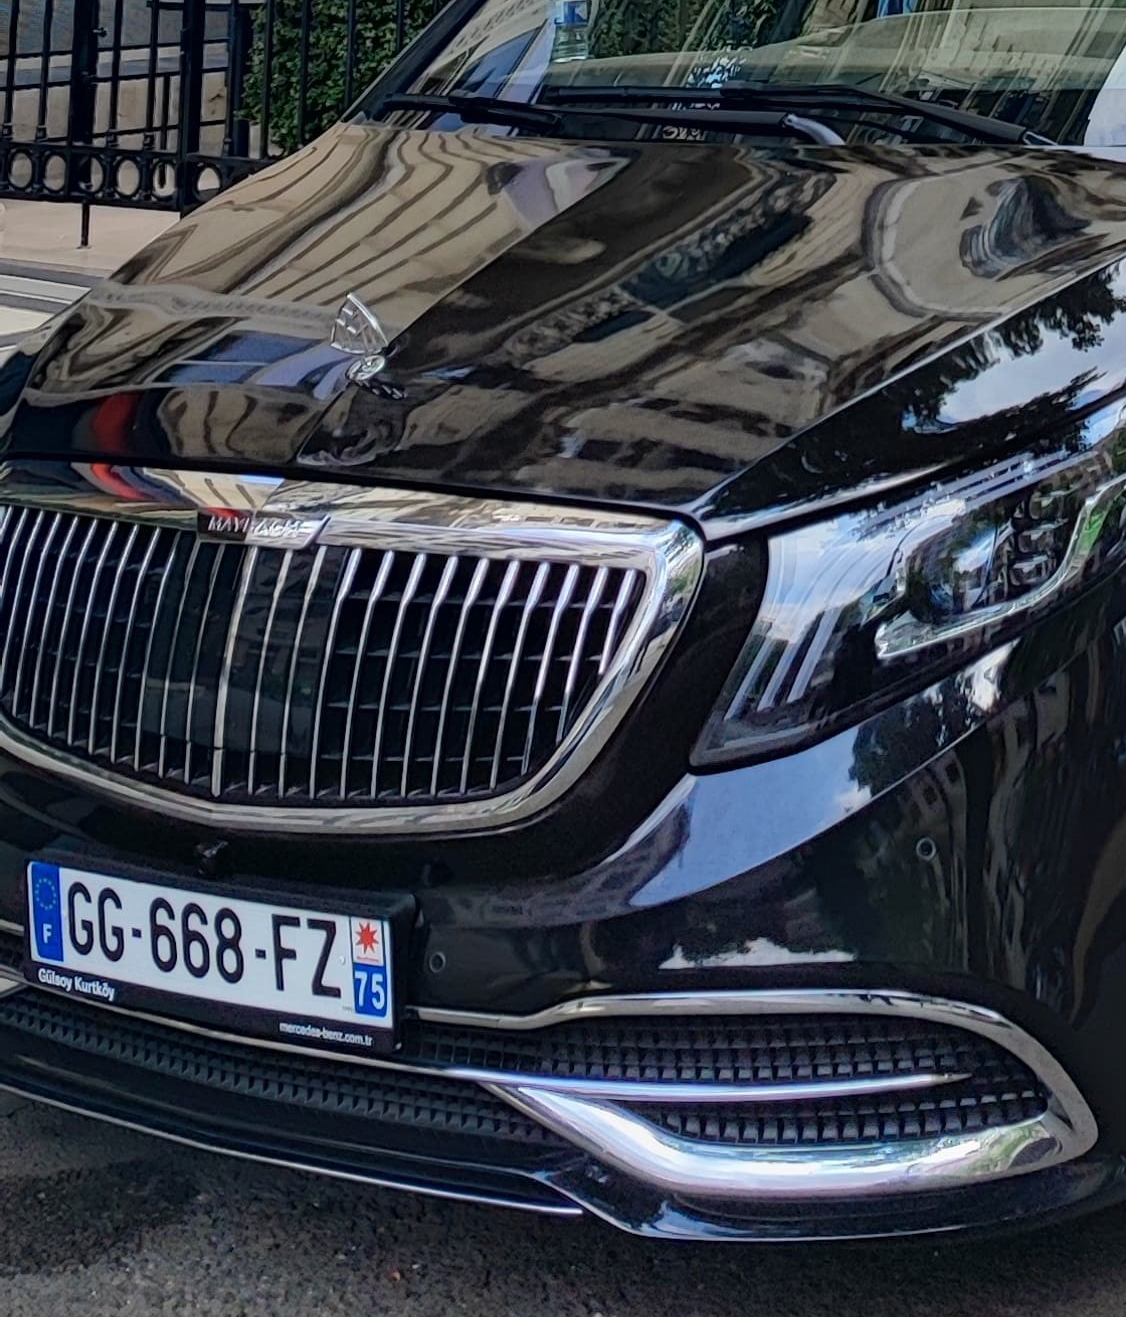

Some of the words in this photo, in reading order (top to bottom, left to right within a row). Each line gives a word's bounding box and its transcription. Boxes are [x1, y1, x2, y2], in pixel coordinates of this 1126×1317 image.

[43, 923, 52, 945] F
[67, 881, 342, 999] GG-668-FZ
[38, 967, 73, 992] Gülsoy
[74, 975, 115, 1002] Kurtköy
[354, 970, 385, 1010] 75
[279, 1022, 373, 1046] mercedes-benz.com.tr
